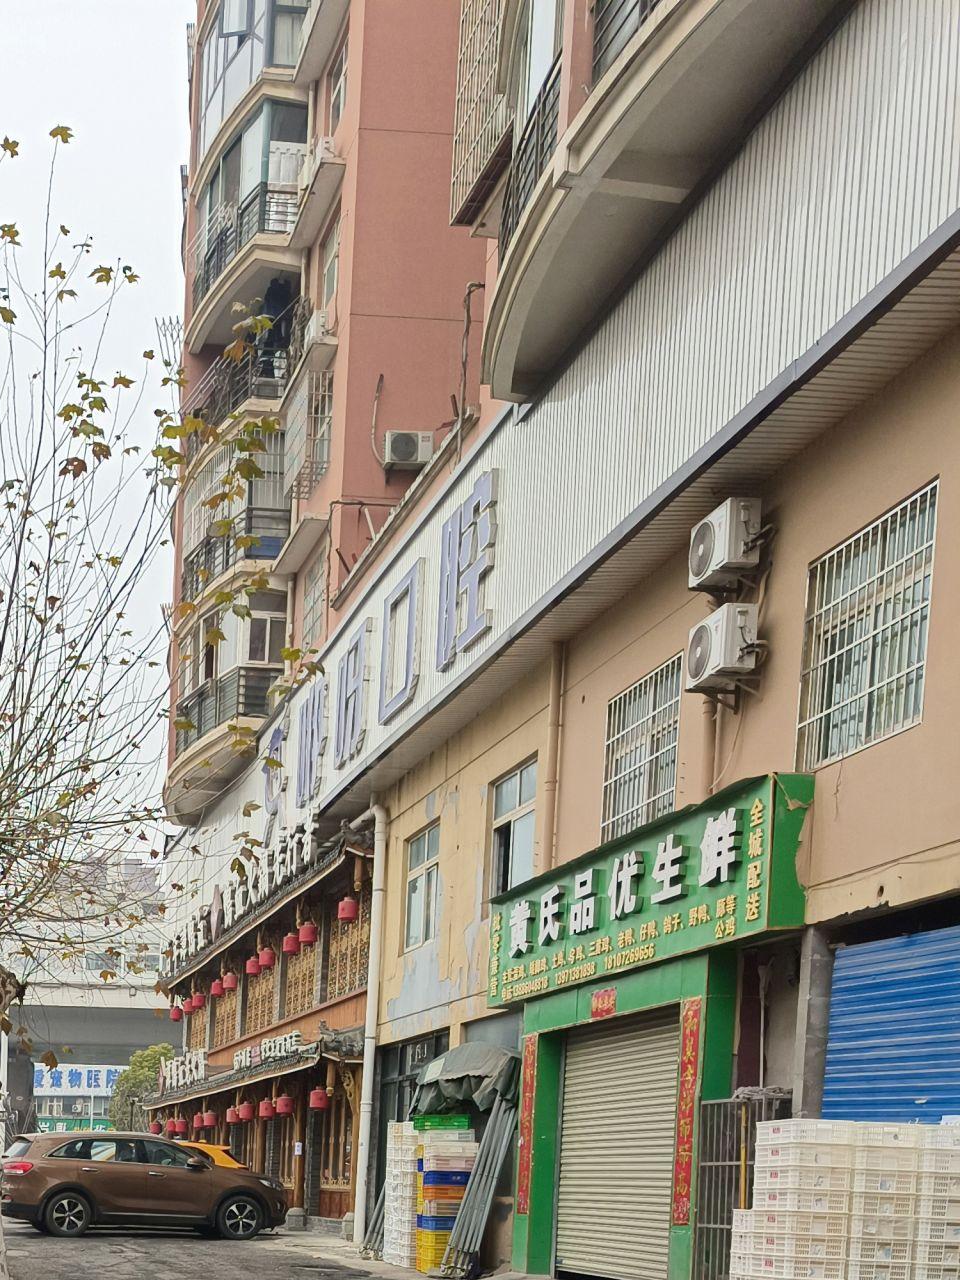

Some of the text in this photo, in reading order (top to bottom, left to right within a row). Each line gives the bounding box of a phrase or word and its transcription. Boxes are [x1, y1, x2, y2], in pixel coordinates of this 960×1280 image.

[508, 807, 737, 958] 黄氏品优生鲜
[745, 798, 765, 922] 全城配送
